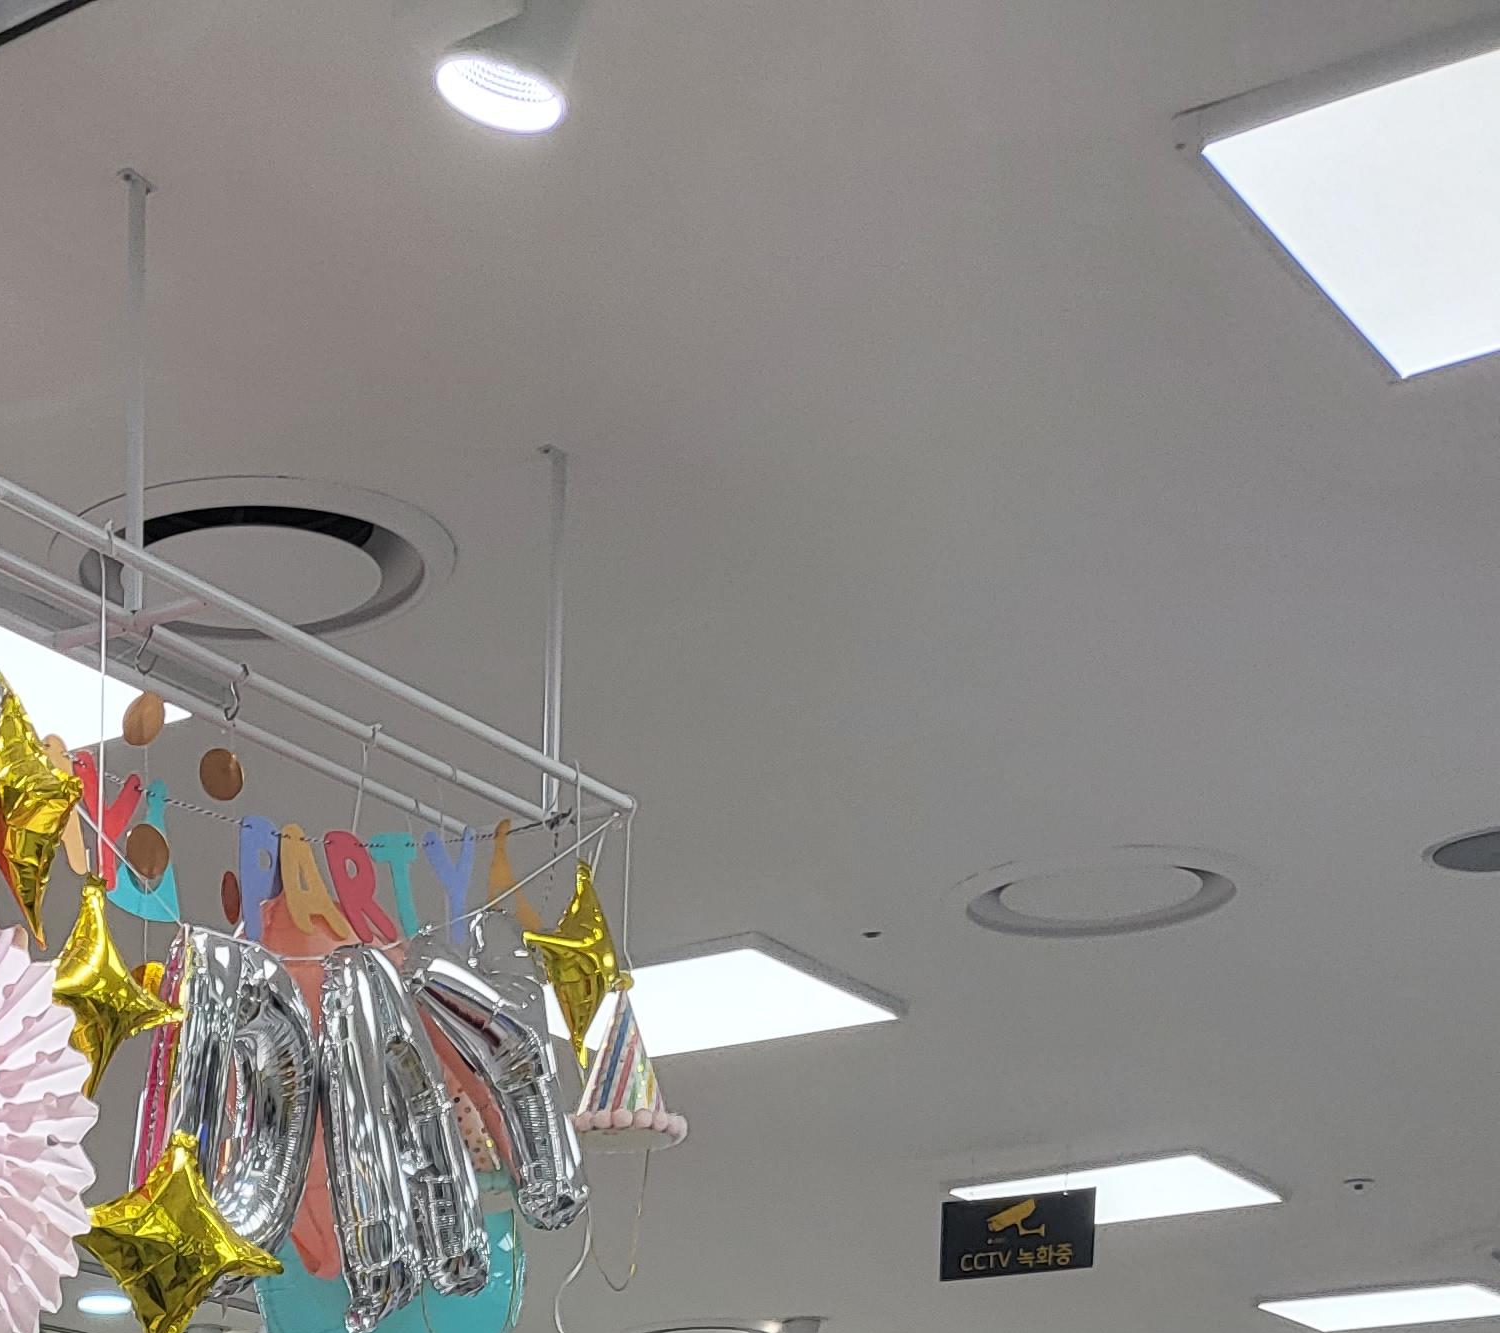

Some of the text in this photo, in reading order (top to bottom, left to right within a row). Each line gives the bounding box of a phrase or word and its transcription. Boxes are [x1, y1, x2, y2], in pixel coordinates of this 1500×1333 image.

[240, 815, 476, 945] PARTY
[960, 1244, 1074, 1272] CCTV 녹화중
